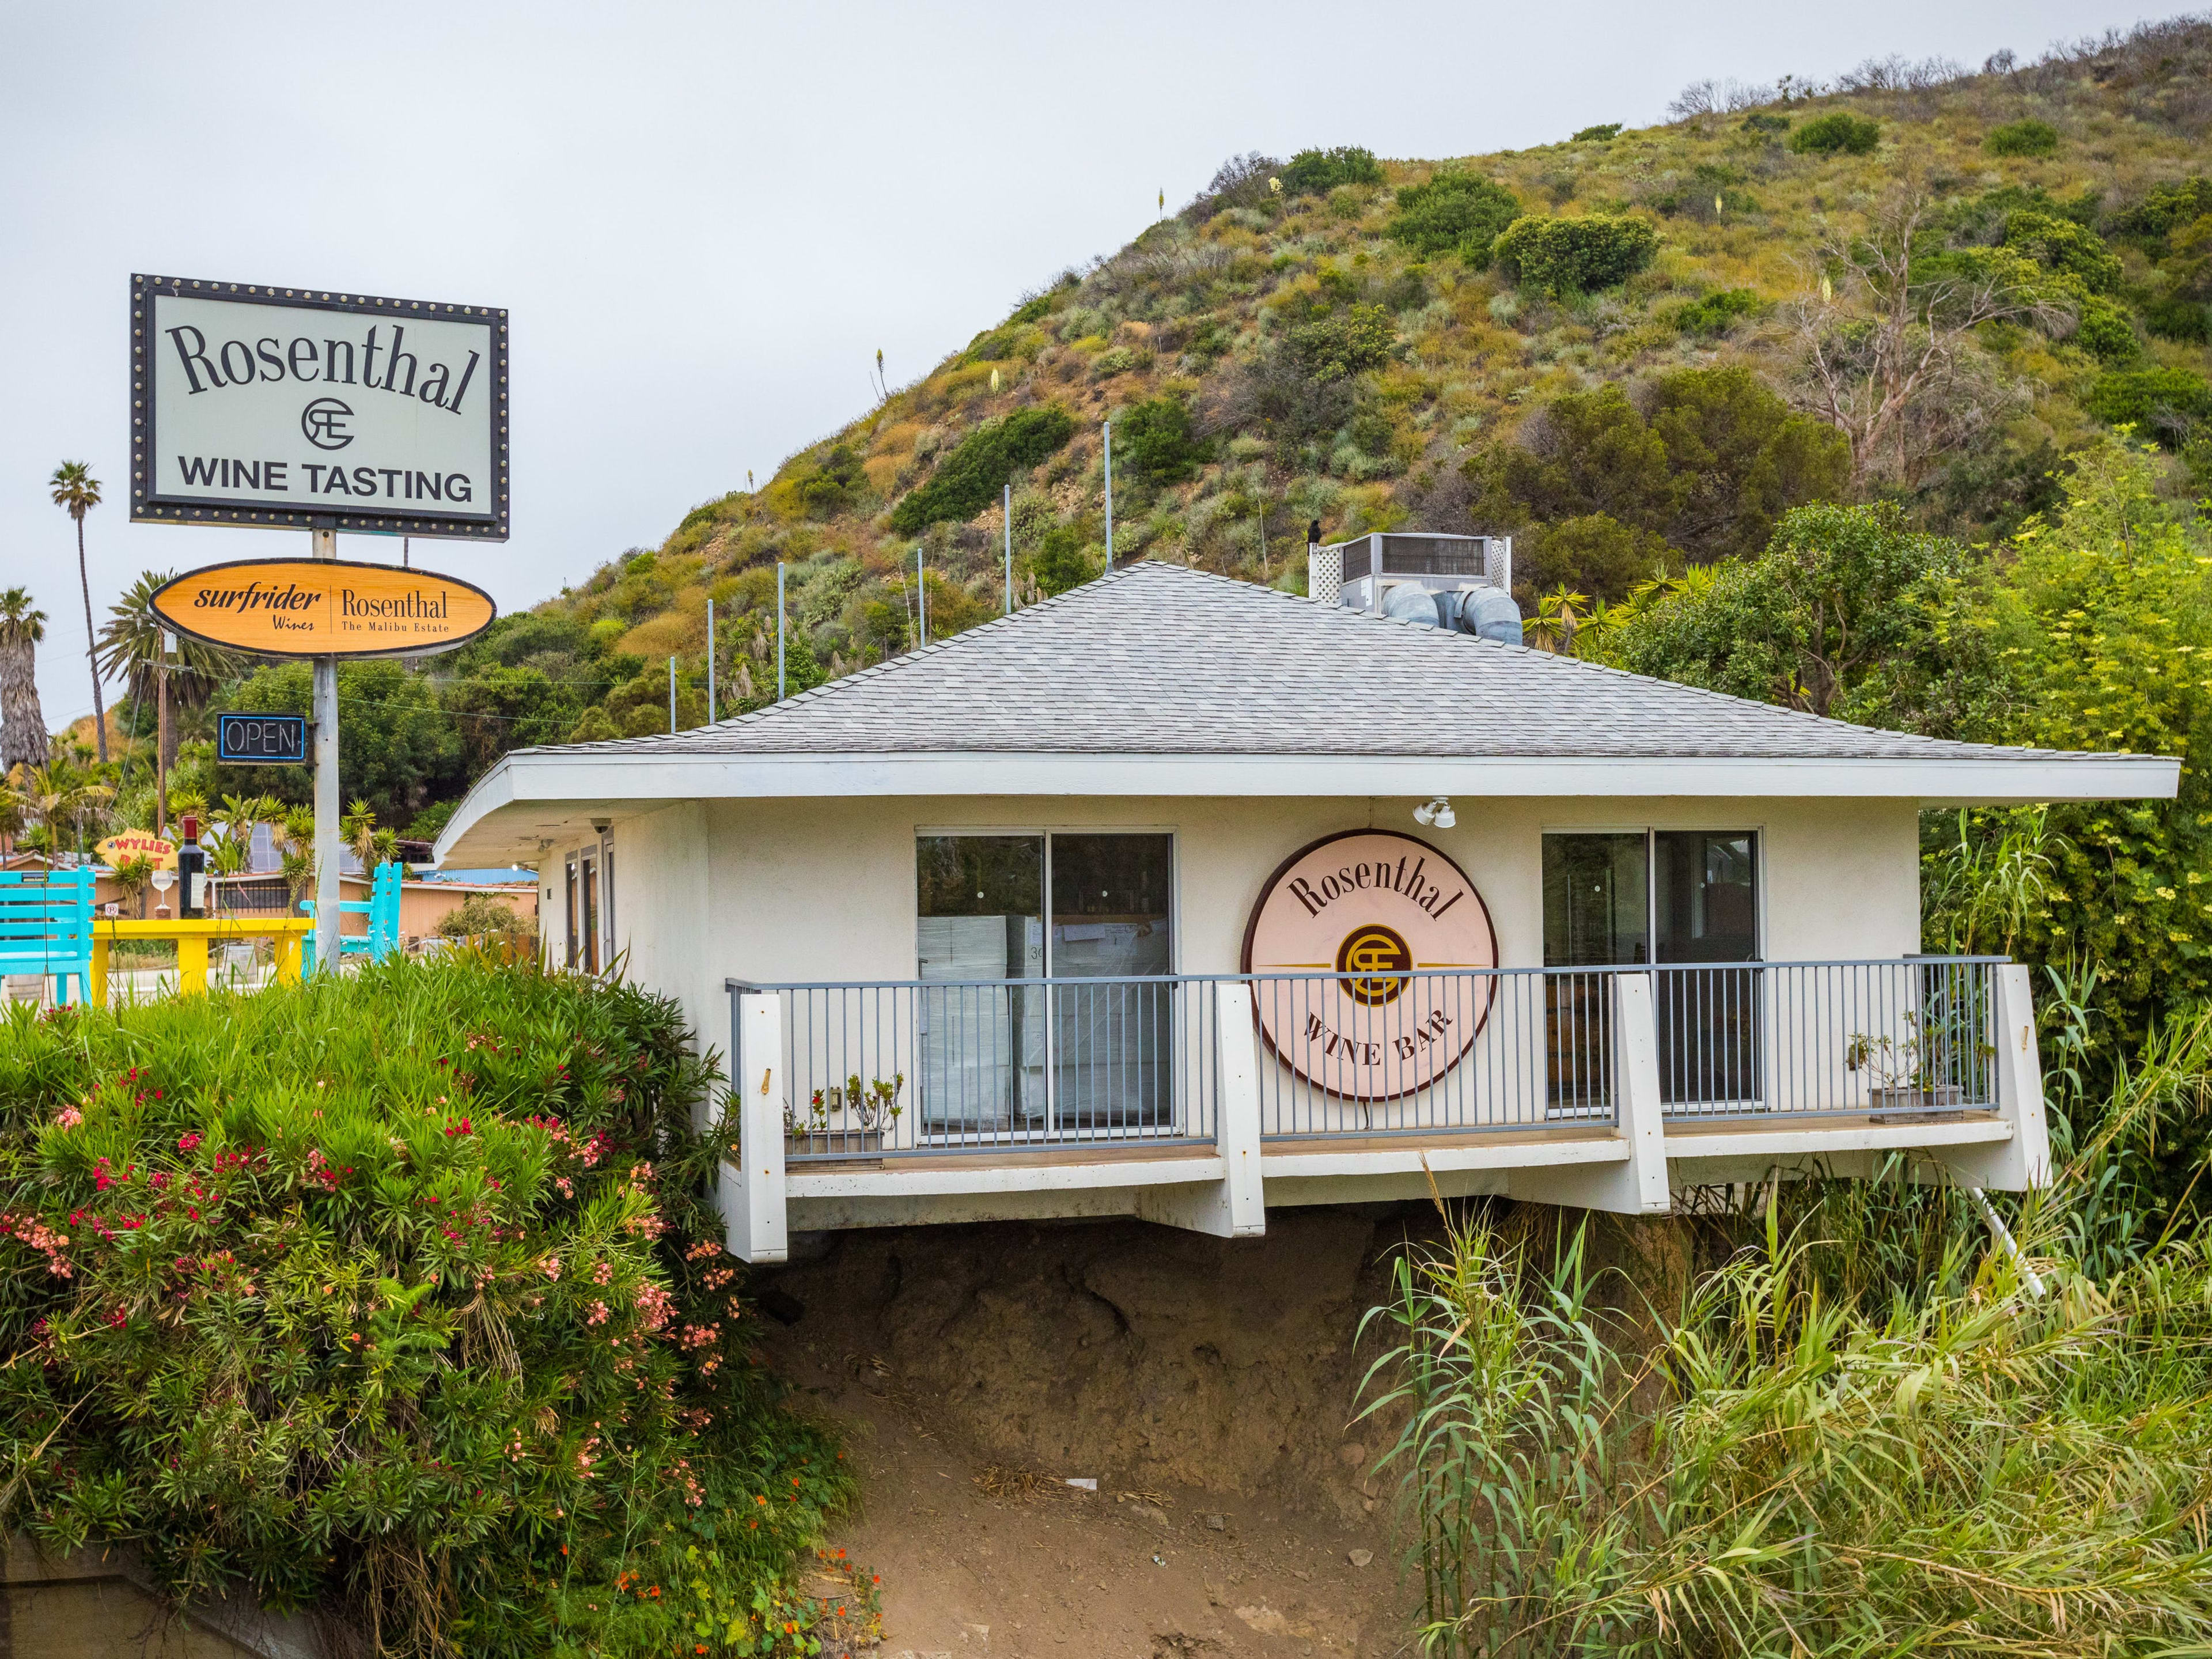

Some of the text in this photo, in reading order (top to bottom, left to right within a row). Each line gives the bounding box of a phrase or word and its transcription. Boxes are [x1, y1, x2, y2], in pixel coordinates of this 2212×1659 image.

[165, 324, 480, 415] Rosenthal
[177, 456, 472, 502] WINE TASTING
[194, 581, 321, 613] surfrider
[342, 589, 448, 619] Rosenthal
[272, 614, 315, 631] Wines
[342, 622, 449, 632] The Malibu Estate
[226, 721, 295, 753] OPEN
[115, 838, 171, 854] WYLIES
[1286, 855, 1464, 922] Rosenthal
[1303, 1009, 1453, 1066] WINE BAR
